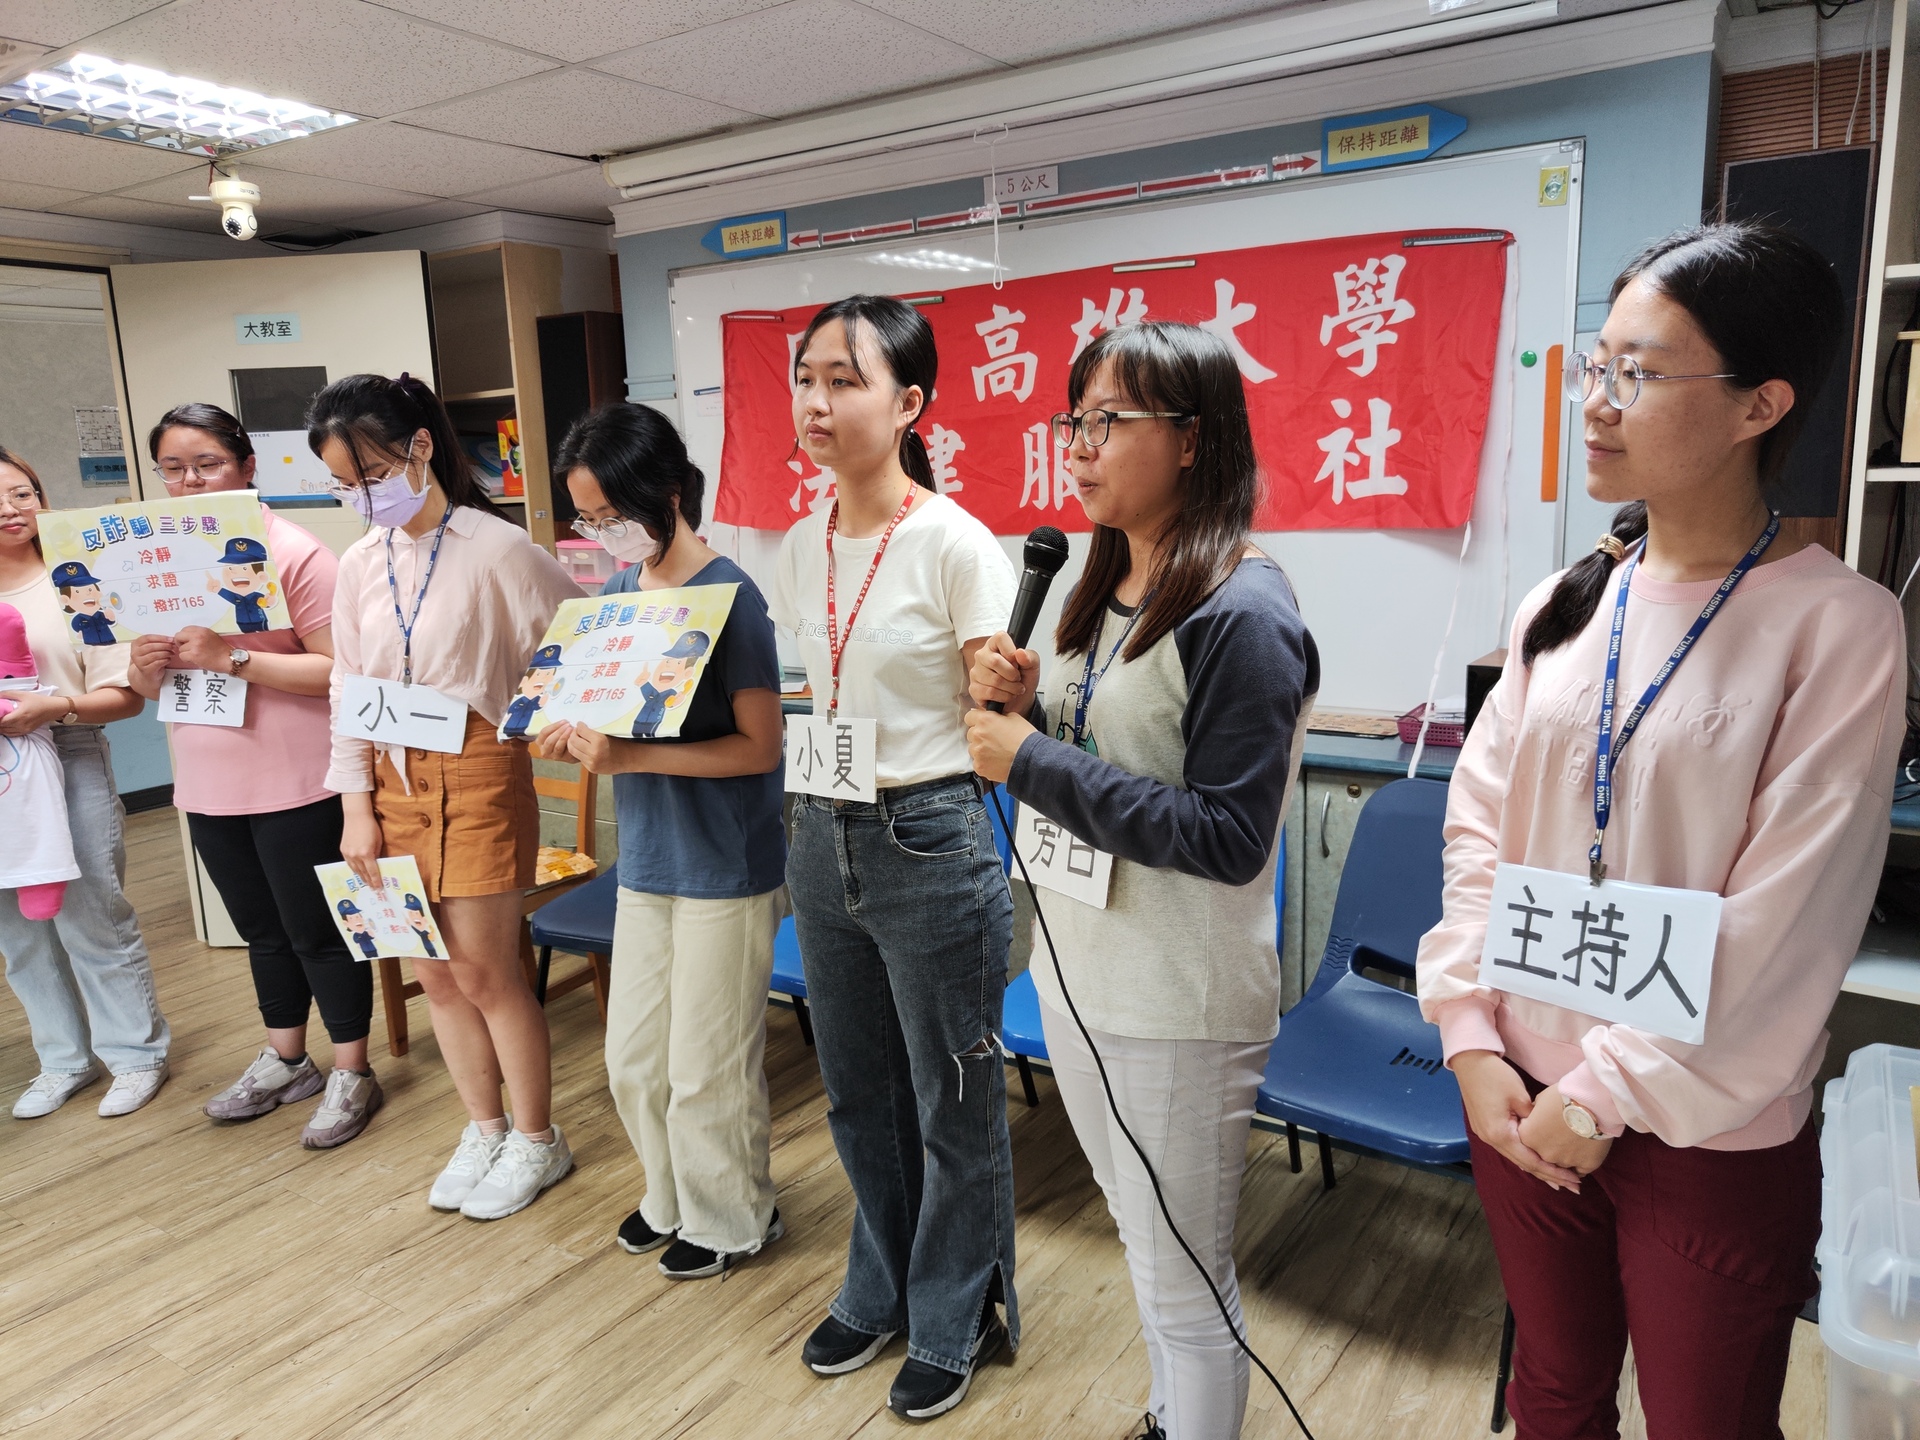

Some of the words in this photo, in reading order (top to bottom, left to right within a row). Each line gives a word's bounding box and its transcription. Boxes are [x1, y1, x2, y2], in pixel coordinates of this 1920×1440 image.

[1337, 124, 1420, 154] 保持距離
[995, 173, 1050, 196] .5公尺
[729, 225, 776, 246] 保持距離
[243, 320, 292, 338] 大教室
[81, 514, 221, 551] 反詐騙三步驟
[1750, 534, 1771, 556] HSING
[138, 546, 172, 566] 冷靜
[146, 572, 180, 590] 求證
[1720, 568, 1744, 592] T'UNG
[153, 595, 205, 613] 撥打165
[1701, 593, 1724, 620] HSING
[574, 601, 692, 636] 反詐騙三步驟
[1613, 606, 1624, 632] HSING
[602, 635, 635, 653] 冷靜
[1609, 634, 1620, 660] T'UNG
[1672, 634, 1695, 659] T'UNG
[591, 661, 621, 679] 求證
[1652, 660, 1675, 687] HSING
[173, 673, 228, 715] 警察
[579, 688, 626, 705] 撥打165
[1604, 678, 1615, 706] HSING
[358, 686, 449, 732] 小一
[1602, 709, 1612, 736] T'UNG
[1624, 703, 1646, 730] T'UNG
[1612, 731, 1630, 758] HSING
[796, 724, 861, 793] 小夏
[1597, 754, 1608, 783] HSING
[1597, 785, 1605, 813] T'UNG
[1493, 884, 1699, 1019] 主持人
